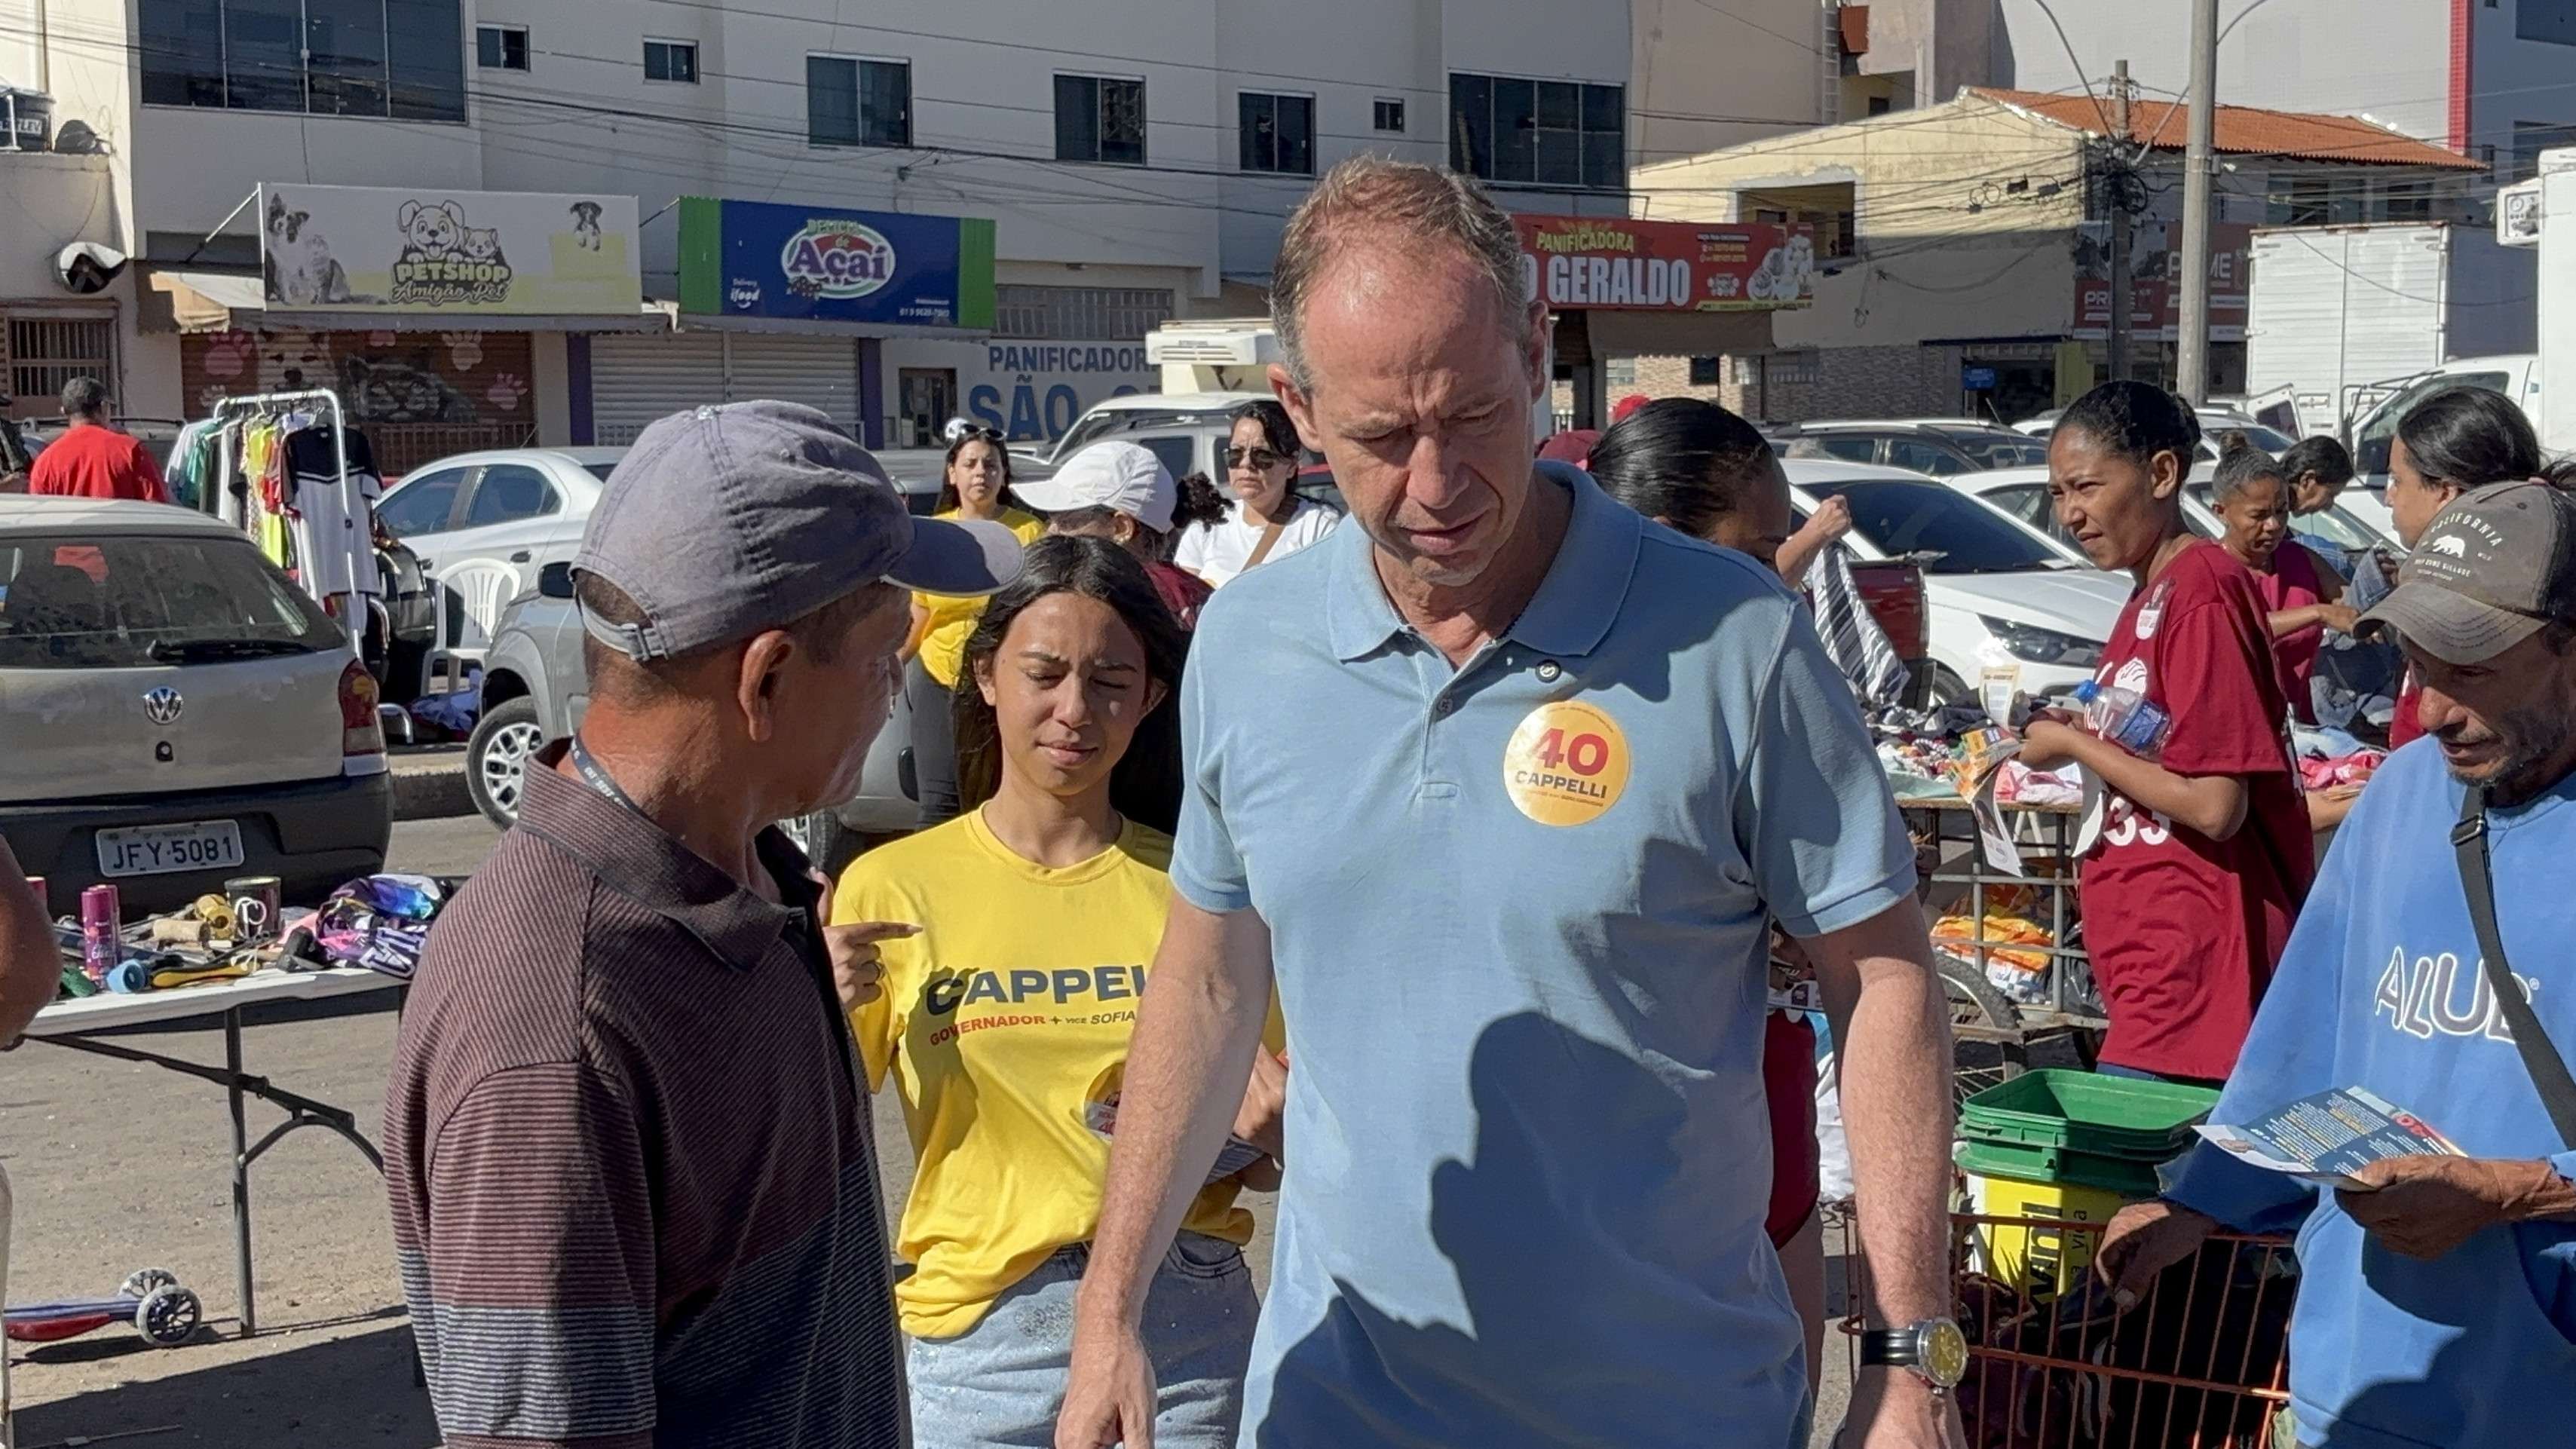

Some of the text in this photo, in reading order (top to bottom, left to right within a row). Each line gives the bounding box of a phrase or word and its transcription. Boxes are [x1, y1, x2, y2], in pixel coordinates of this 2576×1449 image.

[1536, 231, 1634, 253] PANIFICADORA
[1547, 254, 1690, 307] GERALDO
[2167, 251, 2231, 278] PME
[988, 346, 1161, 372] PANIFICADOR
[968, 374, 1080, 443] SÃO
[1533, 727, 1609, 777] 40
[1515, 770, 1608, 798] CAPPELLI
[929, 1015, 1046, 1046] GOVERNADOR
[1090, 1010, 1136, 1025] SOFIA
[2069, 1209, 2087, 1250] via
